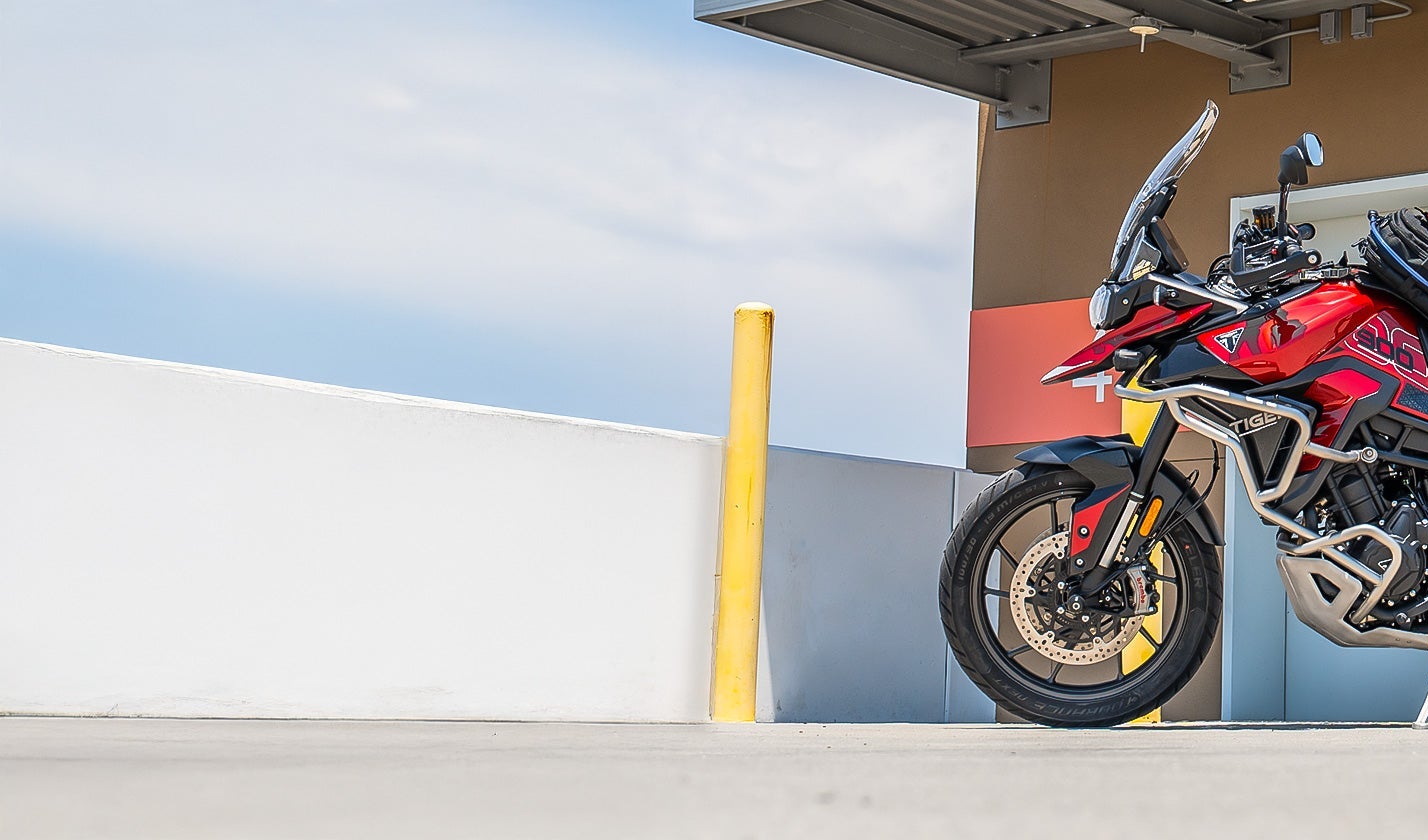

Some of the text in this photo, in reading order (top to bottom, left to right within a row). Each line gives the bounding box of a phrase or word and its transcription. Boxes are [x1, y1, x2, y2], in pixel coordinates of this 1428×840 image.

[1358, 328, 1413, 372] 900
[1229, 411, 1282, 434] TIGE
[1137, 577, 1146, 603] brembo
